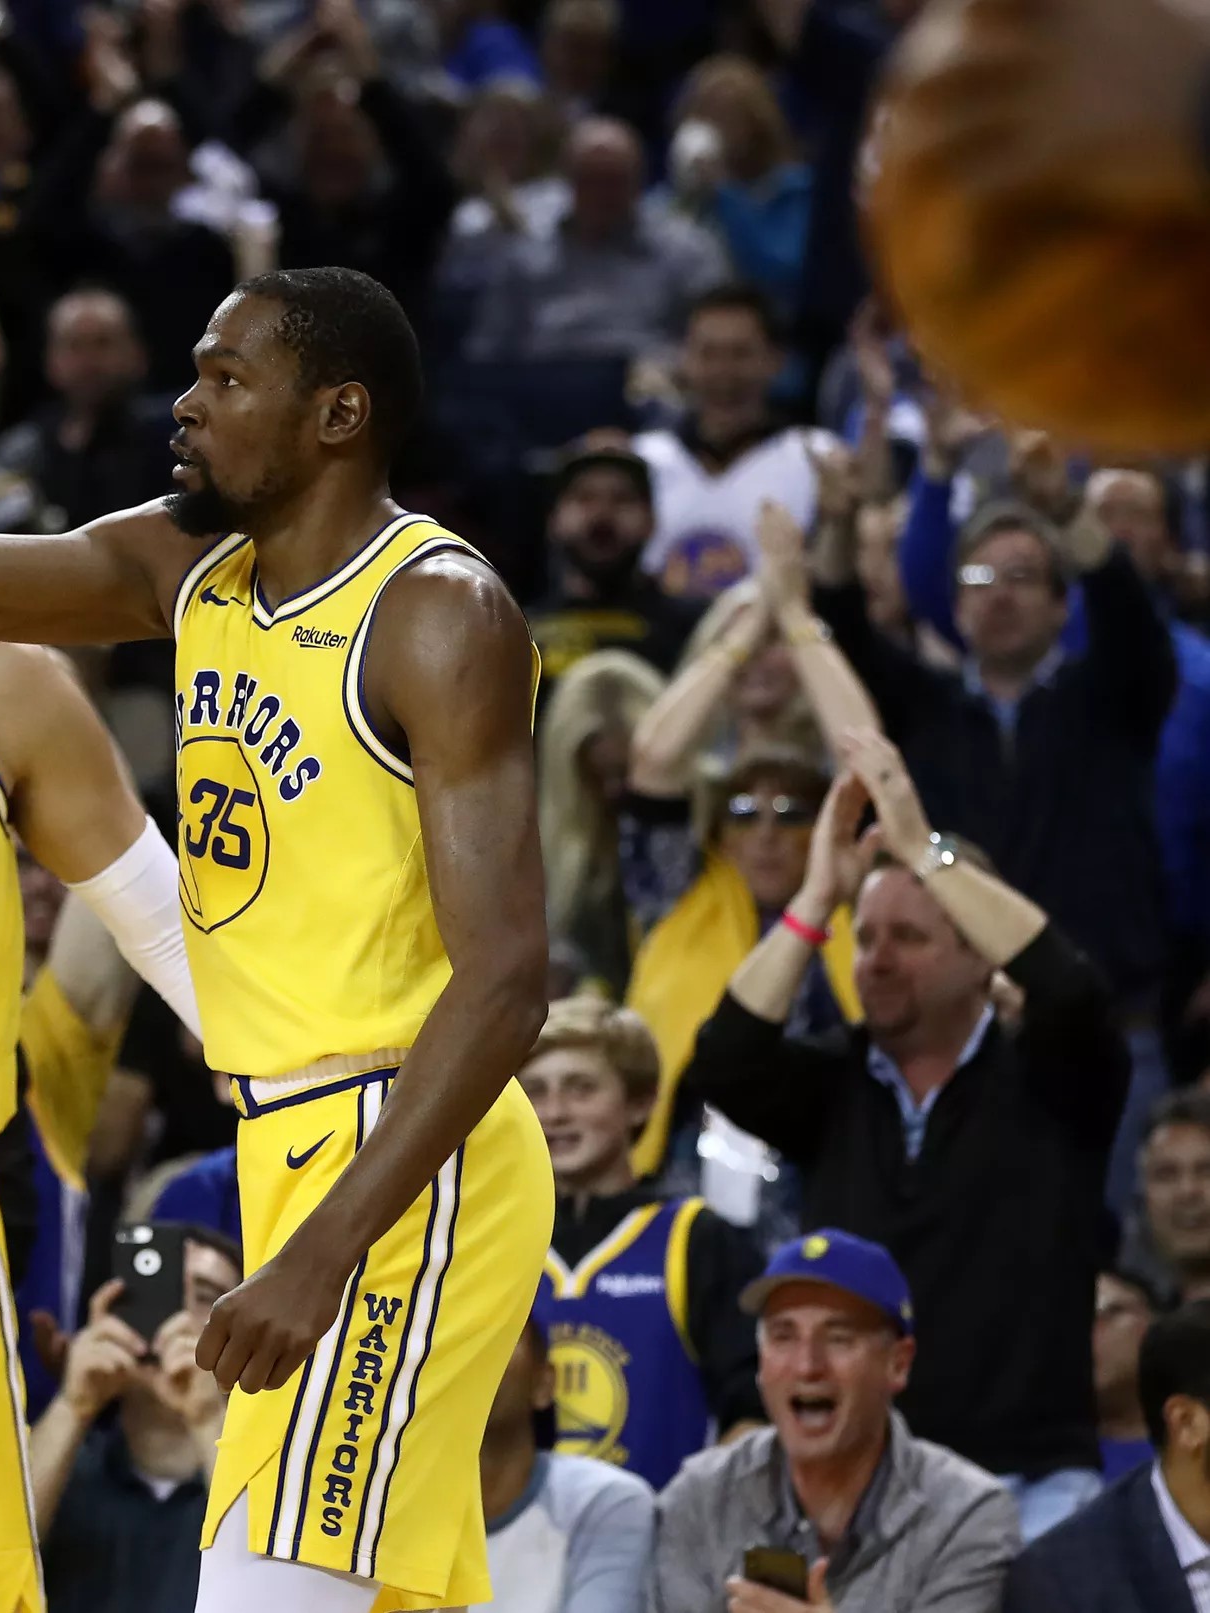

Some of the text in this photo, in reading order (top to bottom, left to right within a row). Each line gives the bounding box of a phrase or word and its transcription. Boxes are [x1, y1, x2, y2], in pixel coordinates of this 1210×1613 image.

[291, 625, 348, 648] Rakuten
[175, 669, 322, 802] RRIORS
[186, 778, 256, 870] 35
[320, 1292, 402, 1537] WARRIORS
